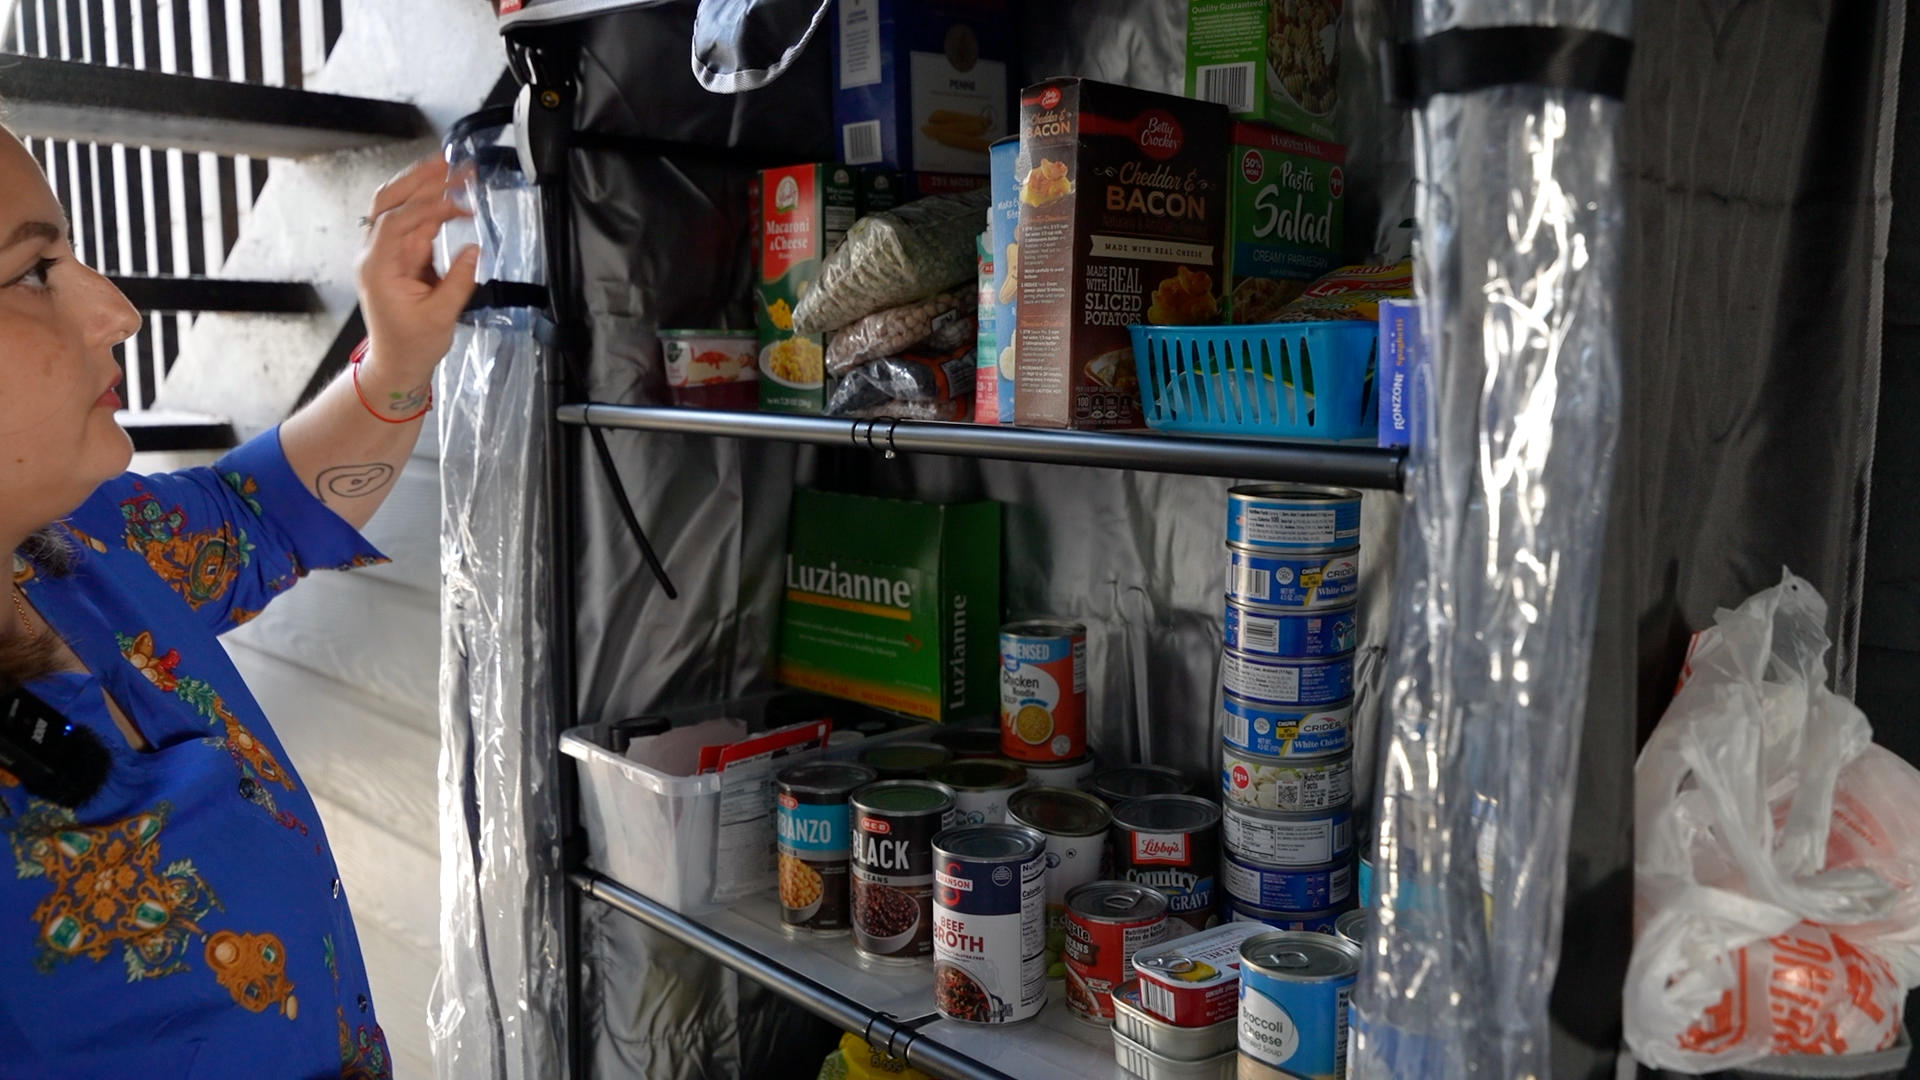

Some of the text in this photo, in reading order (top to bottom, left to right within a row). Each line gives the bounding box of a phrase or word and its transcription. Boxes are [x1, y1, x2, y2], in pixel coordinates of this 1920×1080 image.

[1192, 0, 1267, 15] Quality Guaranteed!
[949, 79, 976, 91] PENNE
[1031, 110, 1059, 125] Cheddar
[1026, 121, 1071, 139] BACON
[1148, 117, 1174, 137] Betty
[1141, 128, 1178, 149] Crocker
[1305, 141, 1322, 155] HILL
[1245, 157, 1262, 169] 50%
[1119, 161, 1183, 191] Cheddar
[1279, 160, 1315, 193] Pasta
[1106, 184, 1206, 220] BACON
[1252, 183, 1333, 249] Salad
[766, 219, 810, 235] Macaroni
[1105, 243, 1203, 258] MADE WITH REAL CHEESE
[1253, 249, 1328, 268] CREAMY PARMESAN
[1086, 265, 1108, 277] MADE
[1086, 266, 1143, 294] WITH REAL
[1311, 281, 1349, 297] La
[1085, 293, 1142, 312] SLICED
[1084, 311, 1141, 326] POTATOES
[1396, 318, 1406, 367] Spaghetti
[1077, 397, 1088, 407] 100
[1391, 373, 1406, 430] RONZONI
[1326, 567, 1355, 578] CRIDER
[787, 554, 912, 609] Luzianne
[1318, 587, 1340, 595] White
[949, 593, 968, 710] Luzianne
[1012, 687, 1036, 698] Noodle
[1304, 722, 1341, 732] CRIDER
[1294, 736, 1346, 749] White Chicken
[727, 759, 752, 768] Nutrition
[1304, 782, 1318, 790] Facts
[864, 820, 886, 831] H-E-B
[853, 829, 909, 870] BLACK
[1139, 839, 1179, 856] Libby's
[863, 872, 888, 884] BEANS
[937, 872, 970, 889] SWANSON
[1126, 867, 1199, 893] Country
[1170, 890, 1210, 911] GRAVY
[940, 916, 964, 932] BEEF
[1125, 924, 1162, 936] Nutrition Facts
[934, 921, 984, 953] BROTH
[1242, 1006, 1283, 1033] Broccoli
[1243, 1022, 1282, 1047] Cheese
[1262, 1044, 1282, 1058] Soup
[872, 1055, 902, 1071] 500 g
